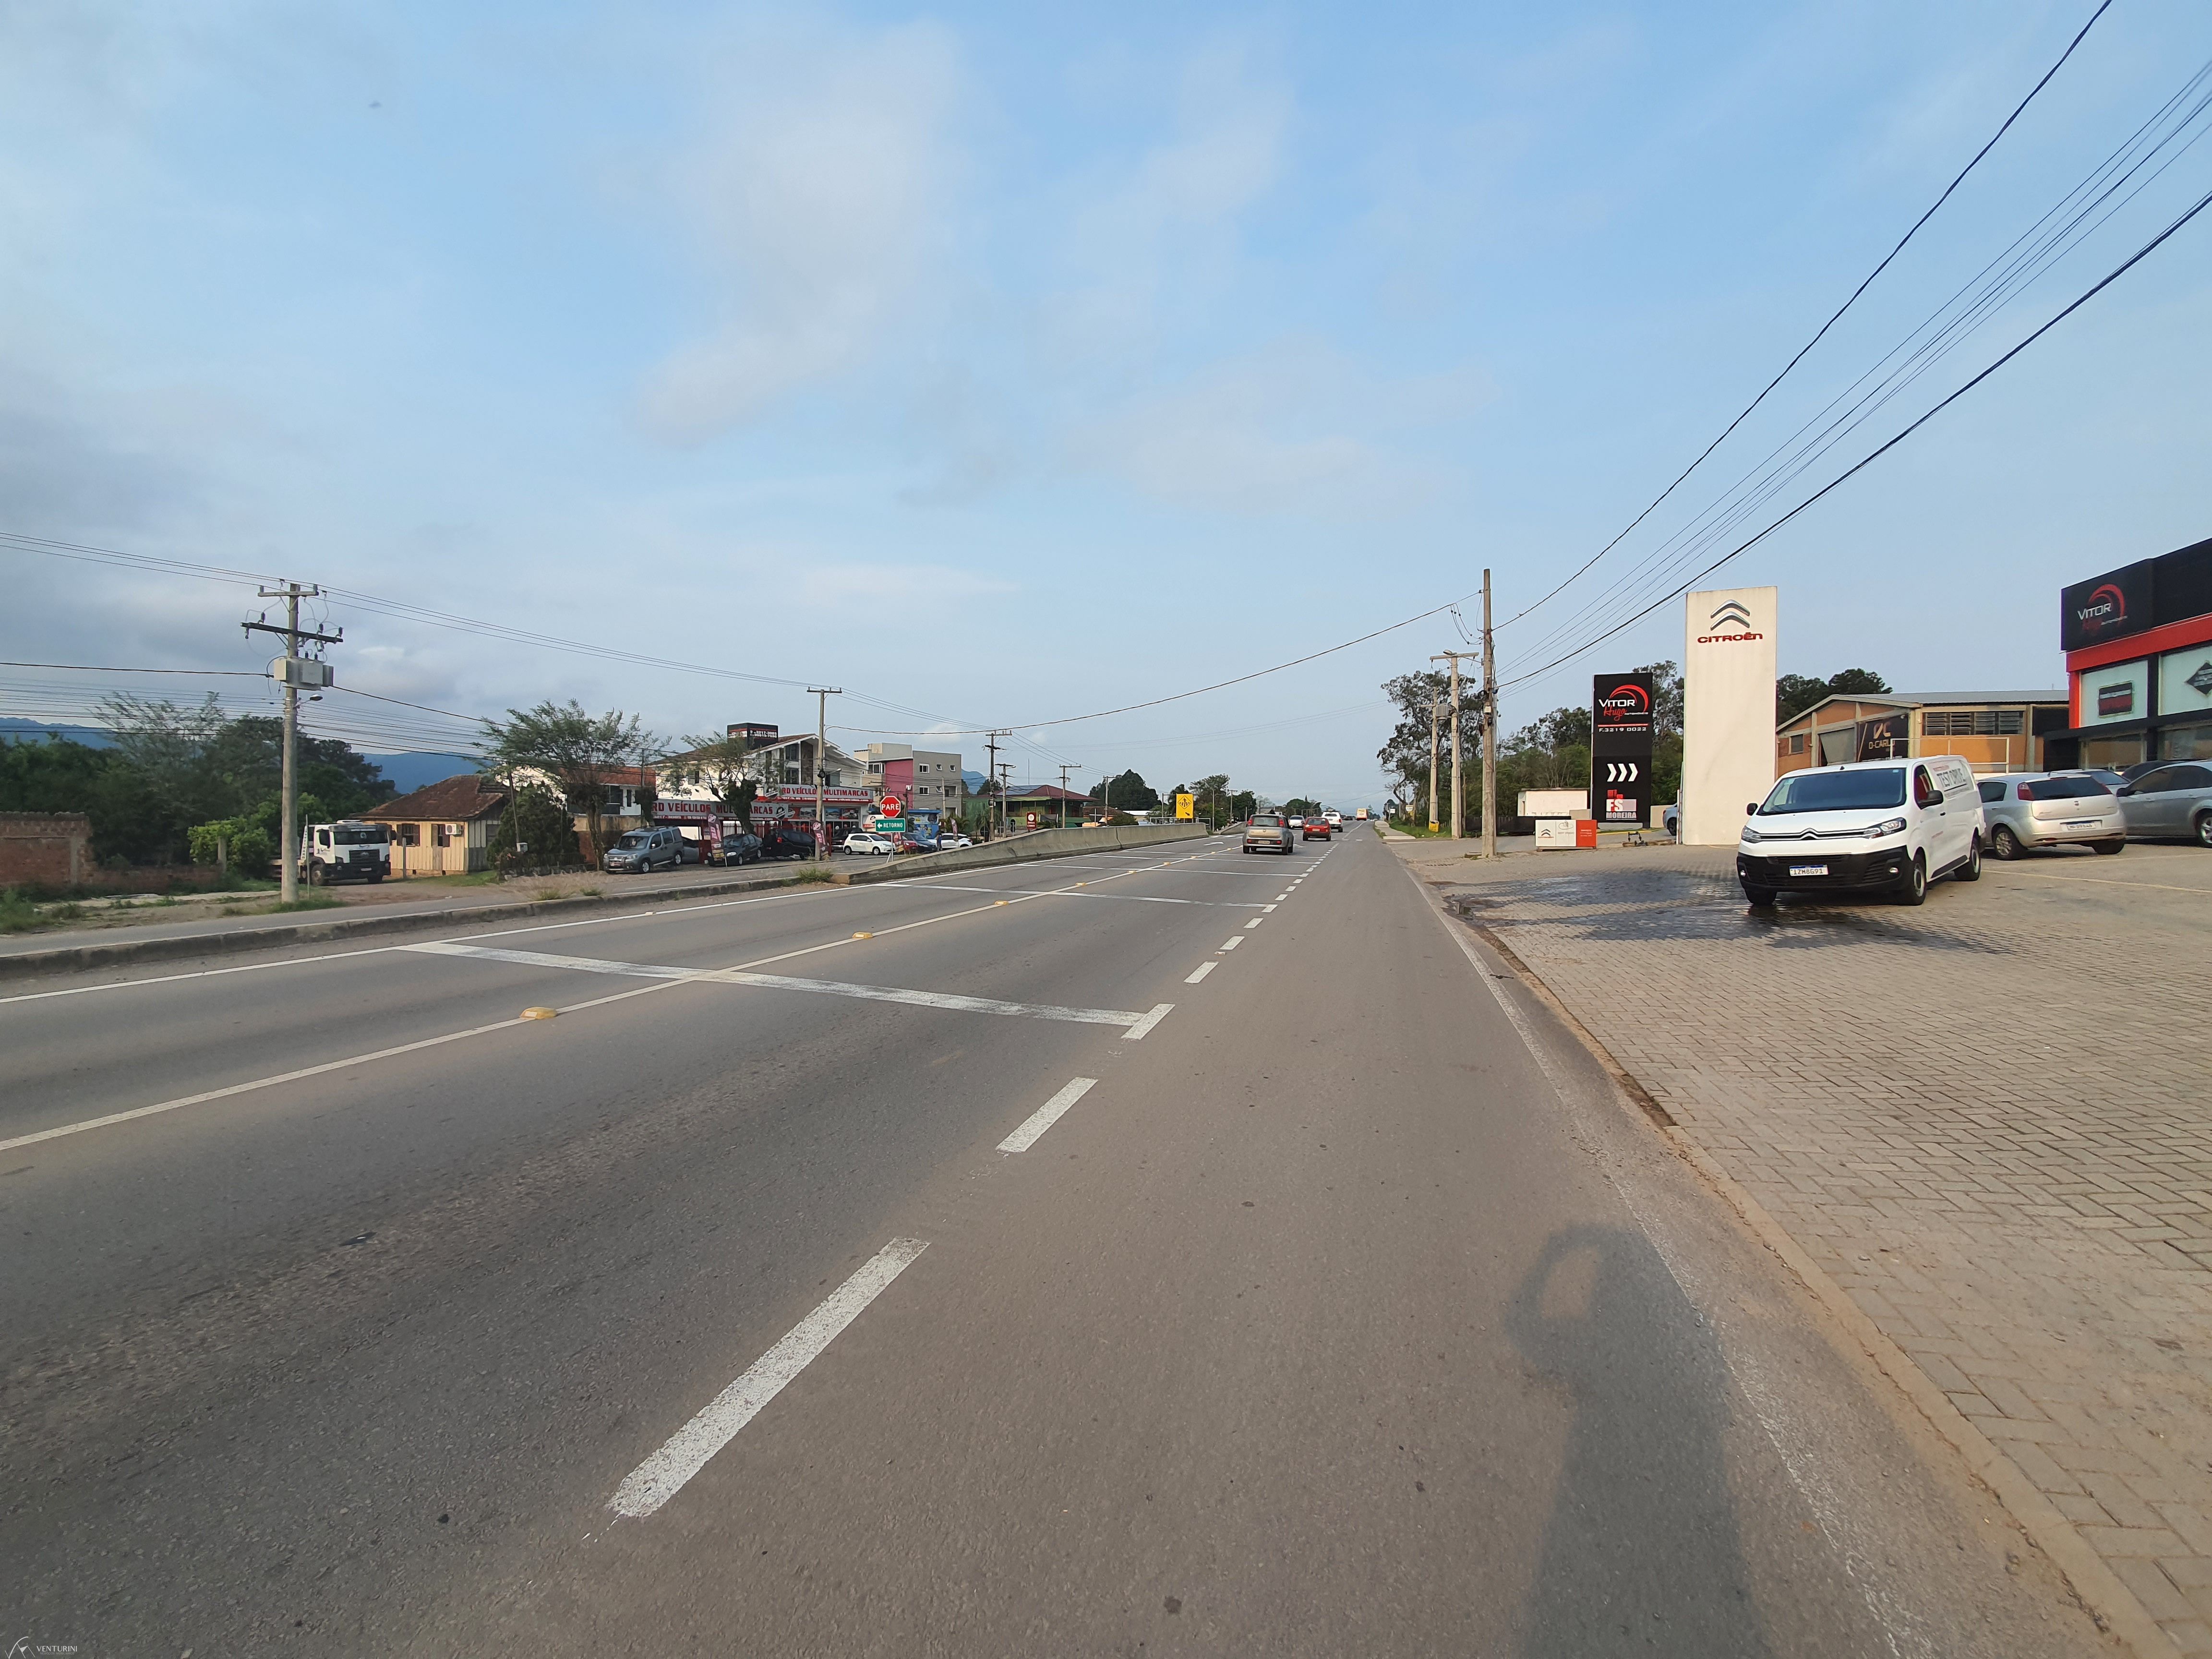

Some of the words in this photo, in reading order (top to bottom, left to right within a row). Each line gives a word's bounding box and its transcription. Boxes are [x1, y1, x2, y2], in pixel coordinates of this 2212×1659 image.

[2077, 602, 2112, 620] VITOR
[1598, 699, 1635, 707] VITOR
[1603, 705, 1627, 721] Hugo
[792, 786, 817, 794] VEÍCULO
[652, 803, 664, 812] RD
[1606, 799, 1623, 811] FS
